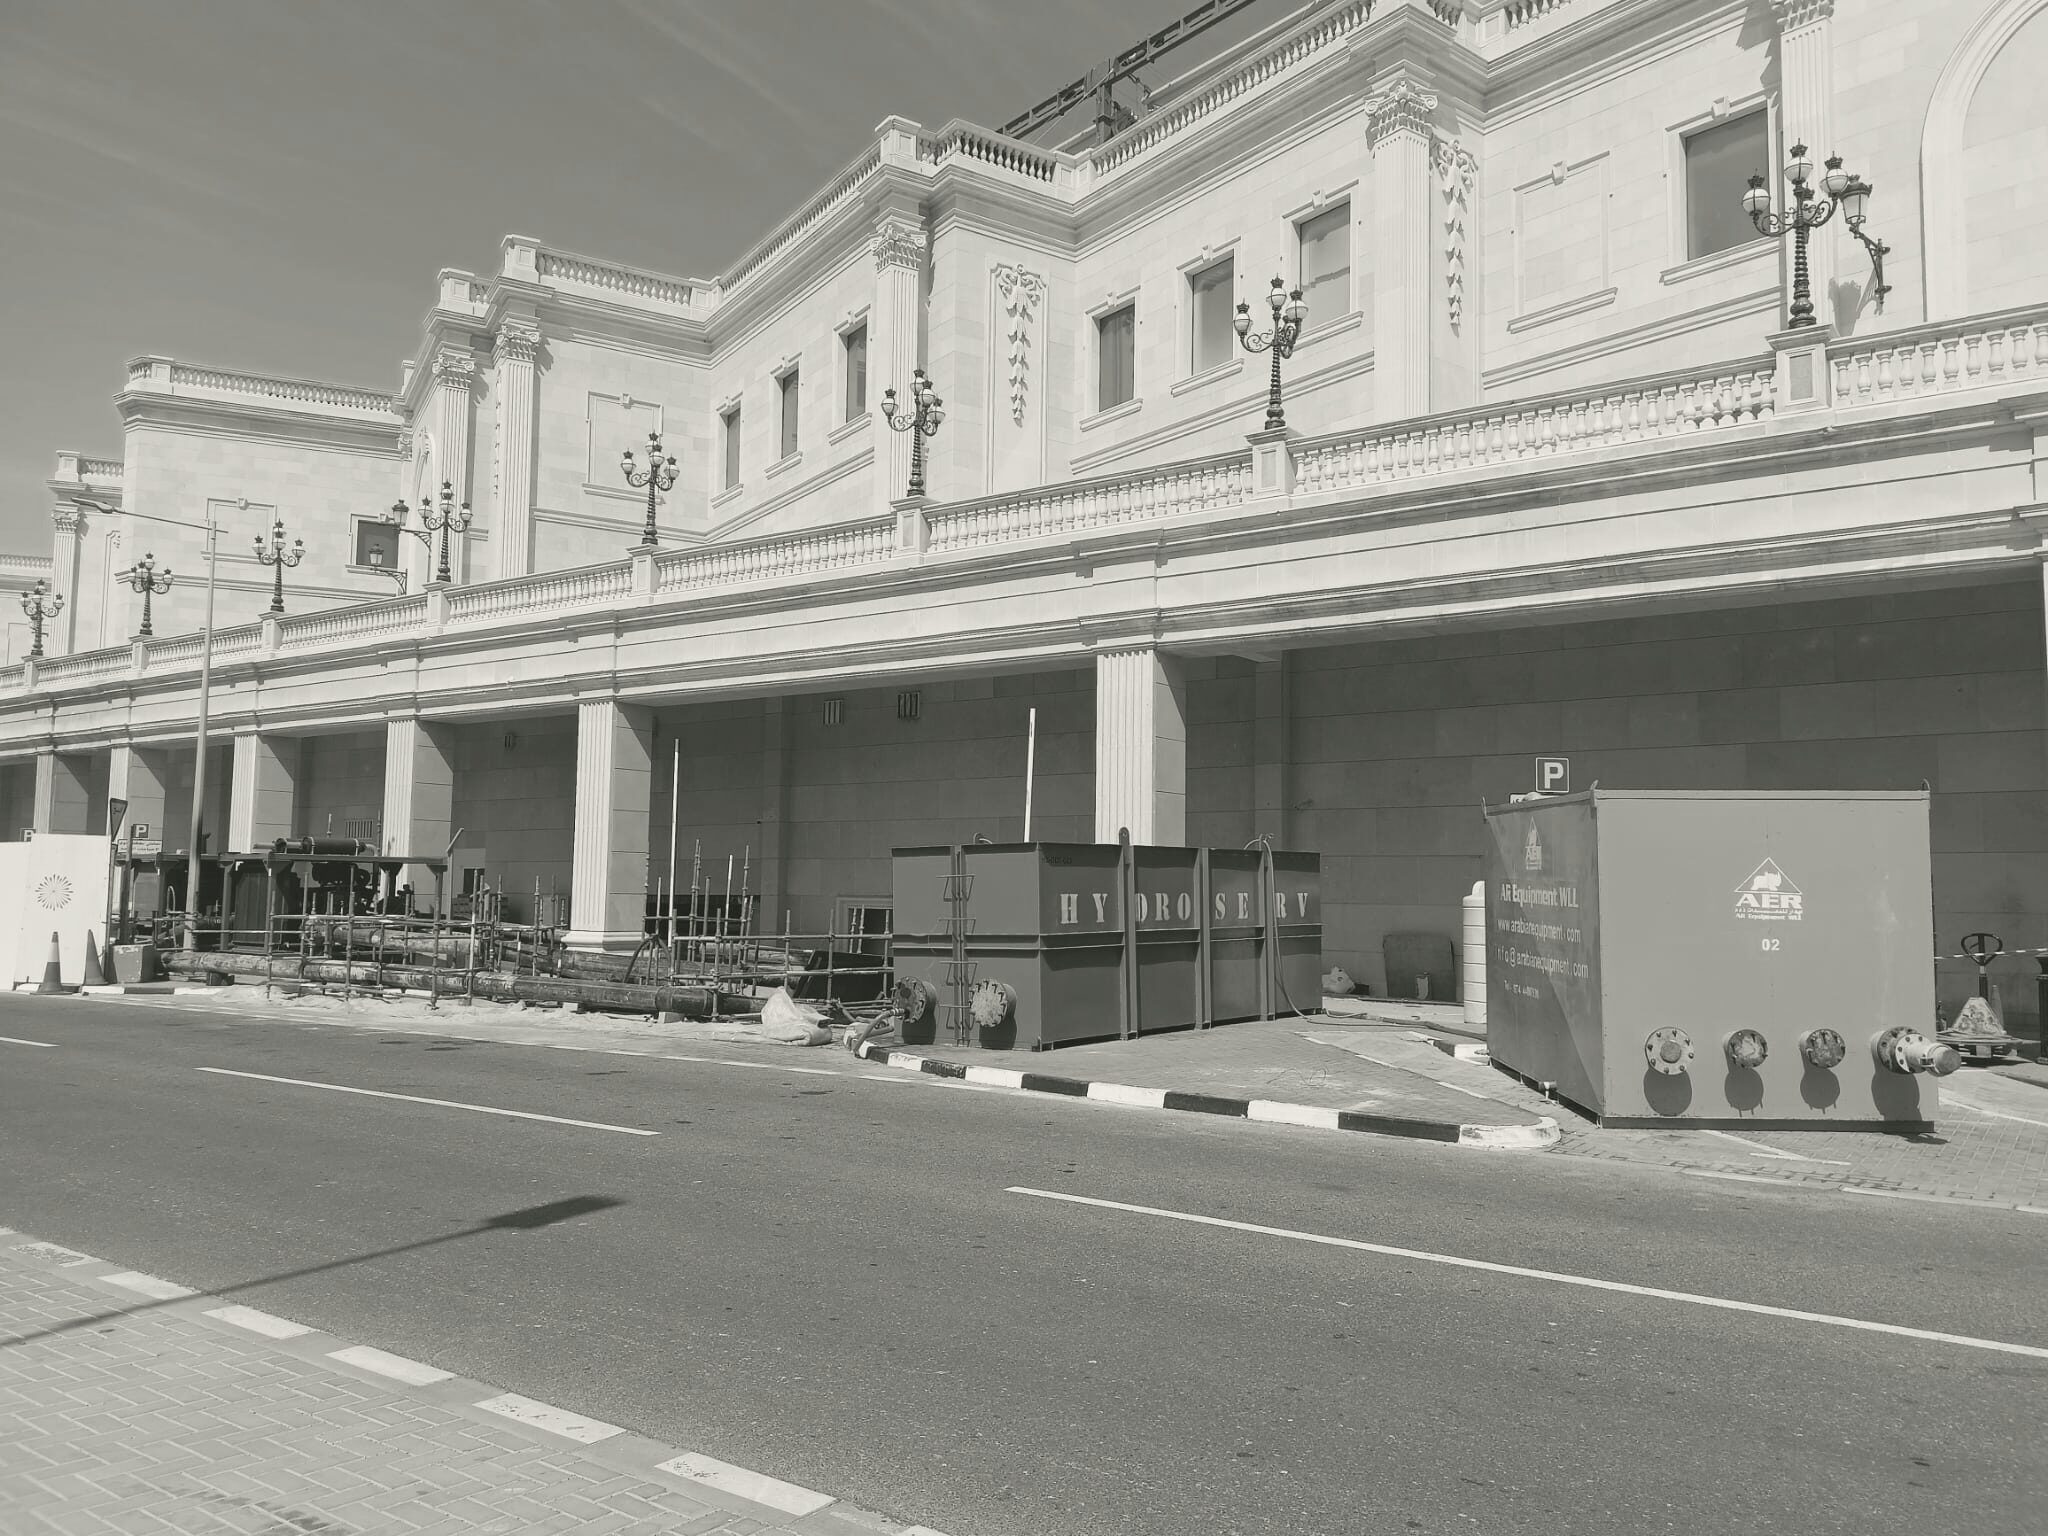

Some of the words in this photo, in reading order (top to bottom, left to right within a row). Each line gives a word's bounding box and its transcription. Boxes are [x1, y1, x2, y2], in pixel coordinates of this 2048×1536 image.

[1543, 761, 1564, 789] P
[135, 825, 147, 838] P
[1512, 884, 1559, 909] Equipment
[1559, 887, 1579, 908] WLL
[1735, 893, 1803, 909] AER
[1761, 938, 1780, 951] 02
